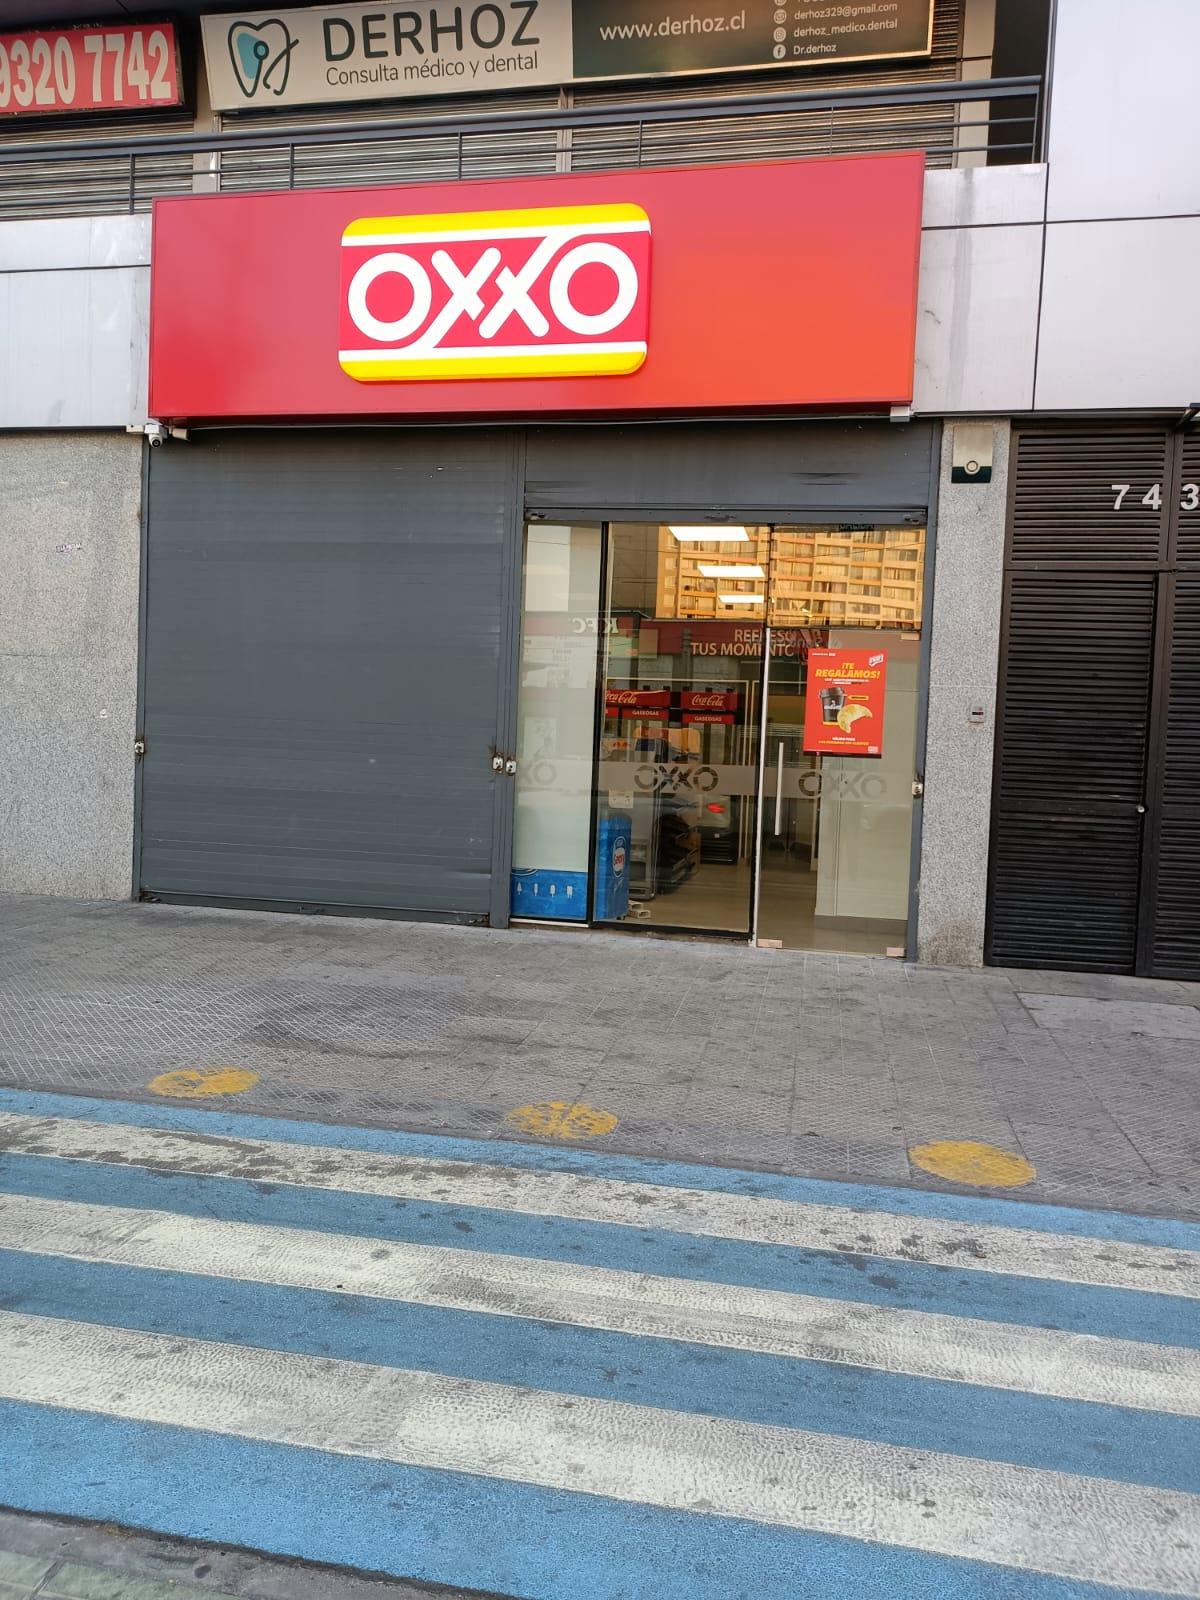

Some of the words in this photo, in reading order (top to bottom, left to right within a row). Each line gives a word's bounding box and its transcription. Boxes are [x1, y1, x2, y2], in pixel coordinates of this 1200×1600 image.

[600, 10, 746, 41] www.derhoz.cl
[794, 3, 897, 20] derhoz329@gmail.com
[322, 1, 540, 62] DERHOZ
[793, 44, 837, 56] Dr.derhoz
[84, 31, 172, 102] 7742
[326, 64, 398, 86] Consulta
[404, 58, 465, 80] médico
[469, 60, 480, 78] y
[484, 51, 538, 73] dental
[348, 239, 639, 346] OXXO
[690, 643, 717, 656] TUS
[815, 669, 881, 680] REGALAMOS!
[634, 765, 719, 792] OXXO
